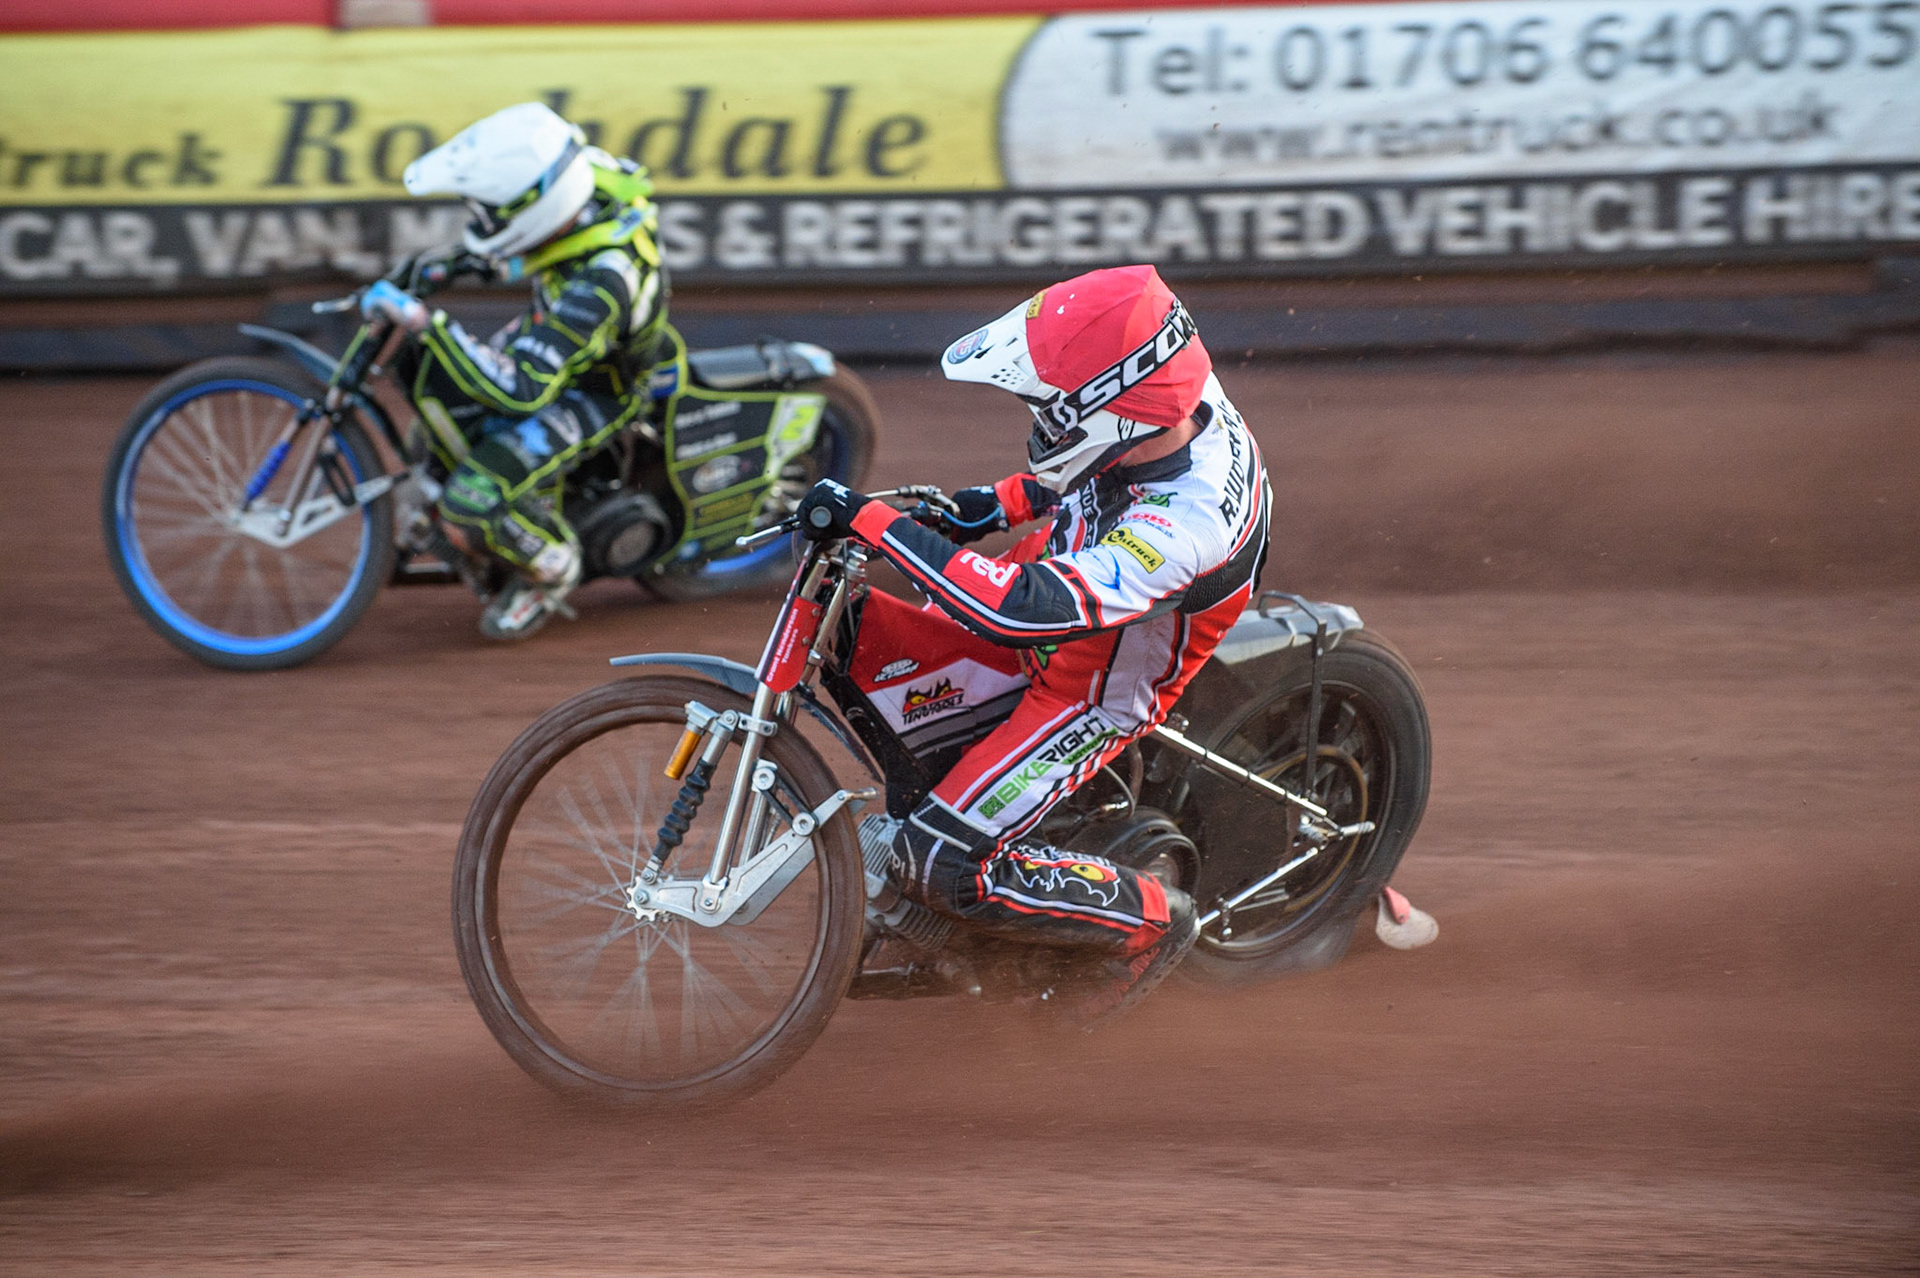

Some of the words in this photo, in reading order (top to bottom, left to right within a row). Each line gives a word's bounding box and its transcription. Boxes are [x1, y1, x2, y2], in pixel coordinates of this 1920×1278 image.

[1091, 28, 1250, 97] Tel:
[1274, 18, 1549, 92] 01706
[1576, 3, 1918, 82] 640055
[0, 132, 220, 187] ruck
[258, 86, 928, 189] Rodale
[716, 205, 775, 268] &
[784, 191, 1370, 266] REFRIGERATED
[1375, 177, 1732, 256] VEHICLE
[1741, 170, 1920, 243] HIRE
[1080, 323, 1185, 418] SCO
[995, 716, 1106, 805] BIKERIGHT
